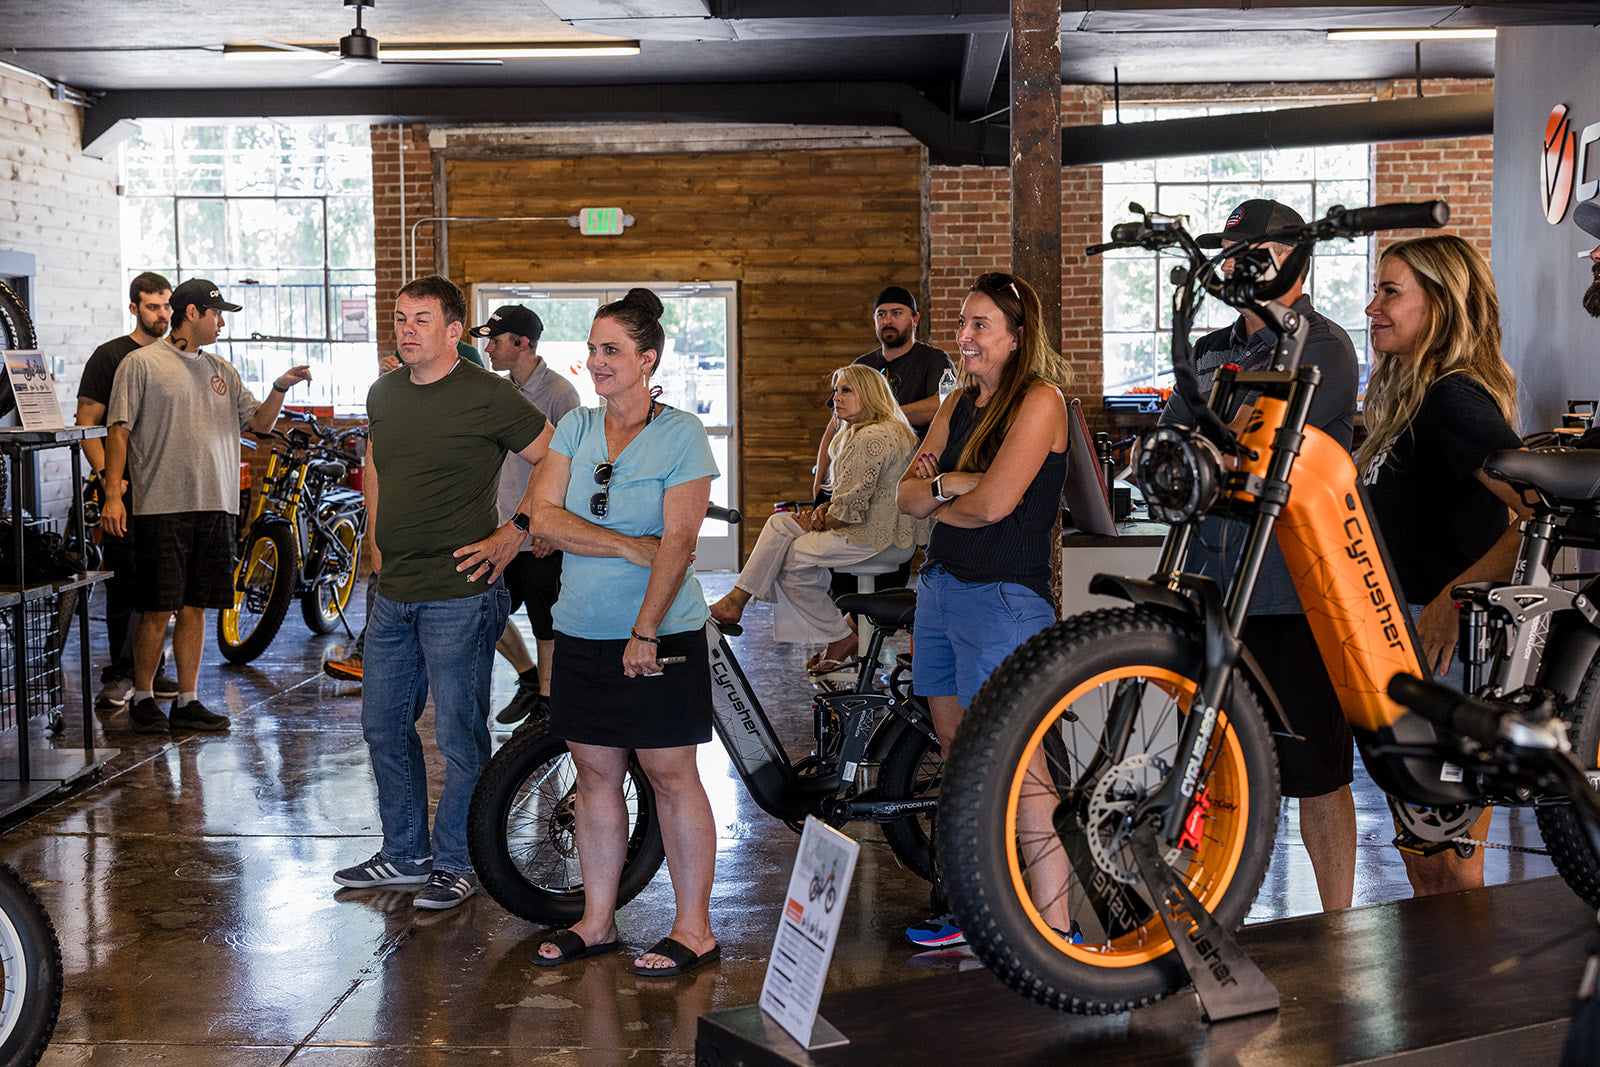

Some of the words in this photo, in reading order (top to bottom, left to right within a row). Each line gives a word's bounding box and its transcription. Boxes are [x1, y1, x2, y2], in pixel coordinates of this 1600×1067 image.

[587, 209, 617, 233] EXIT
[1343, 516, 1406, 653] Cyrusher
[712, 661, 761, 737] Cyrusher
[1180, 706, 1217, 798] CYRUSHER
[1161, 885, 1238, 987] Cyrusher
